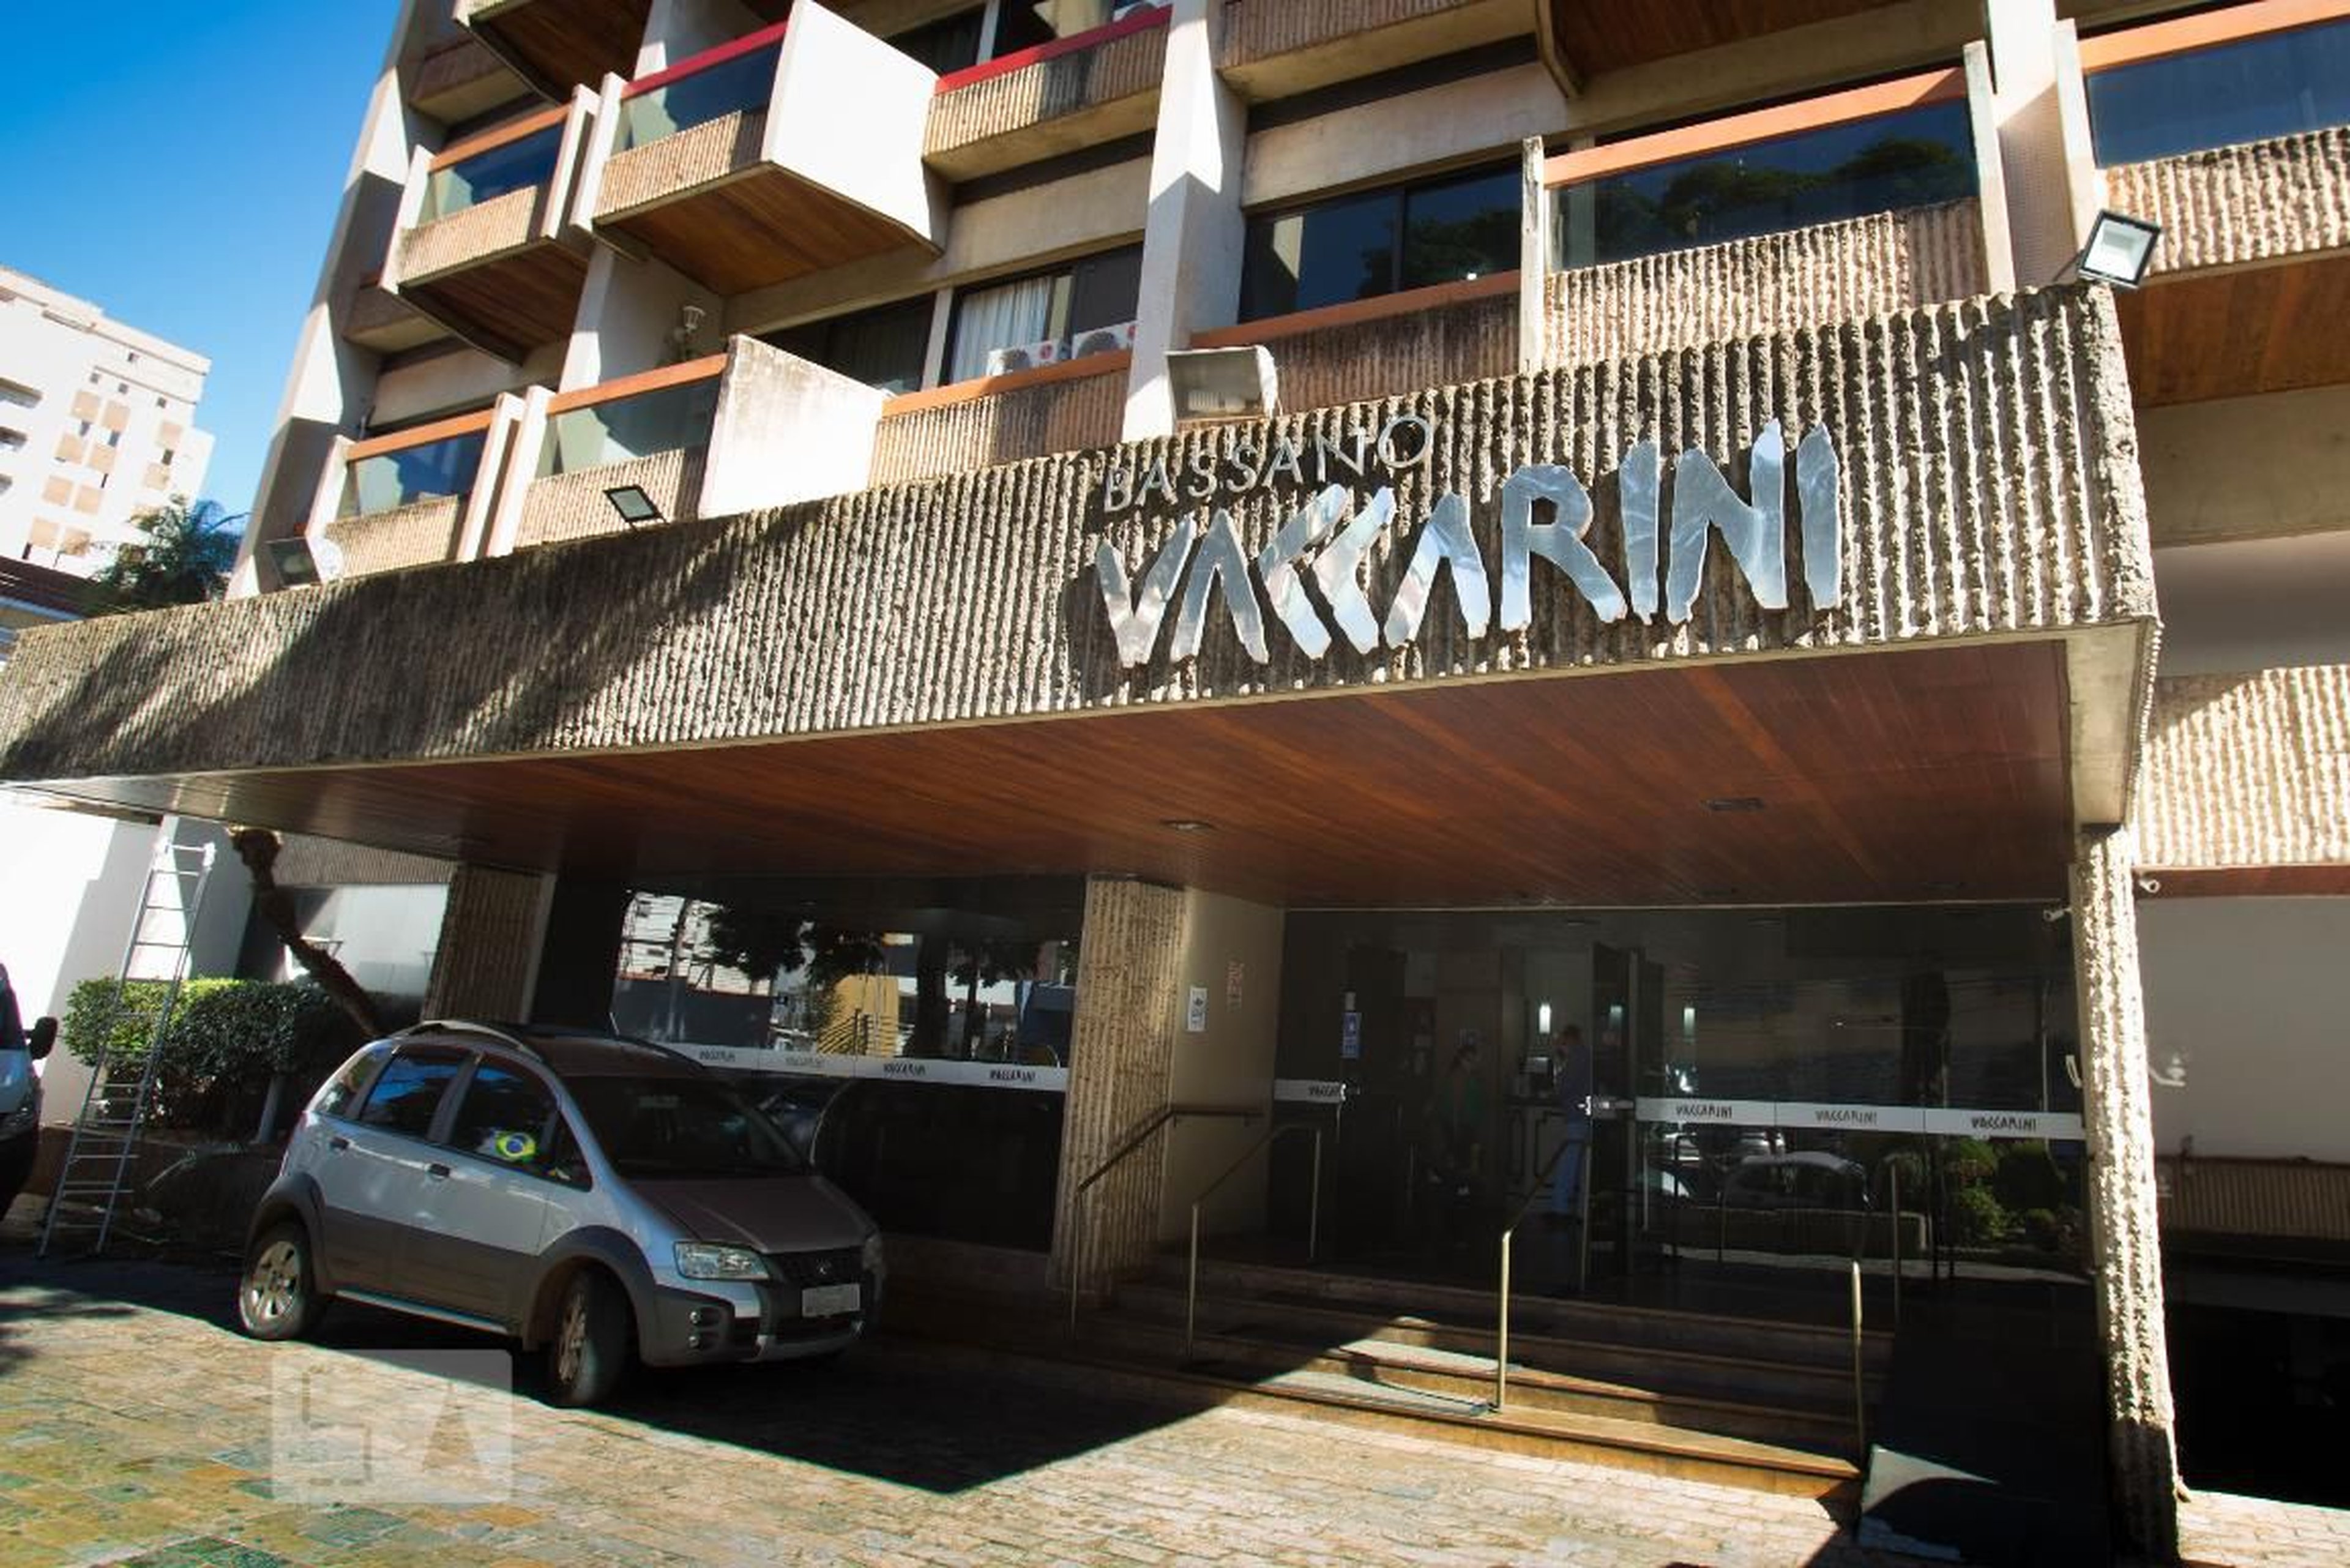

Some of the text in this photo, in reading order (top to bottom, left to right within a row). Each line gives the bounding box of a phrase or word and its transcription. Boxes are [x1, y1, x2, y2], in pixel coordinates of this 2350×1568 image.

[1103, 414, 1433, 513] BASSANO
[1099, 417, 1842, 668] VACCARINI
[1676, 1103, 1733, 1119] VACCARINI
[1815, 1110, 1878, 1127] VACCARINI
[1971, 1116, 2037, 1133] VACCARINI
